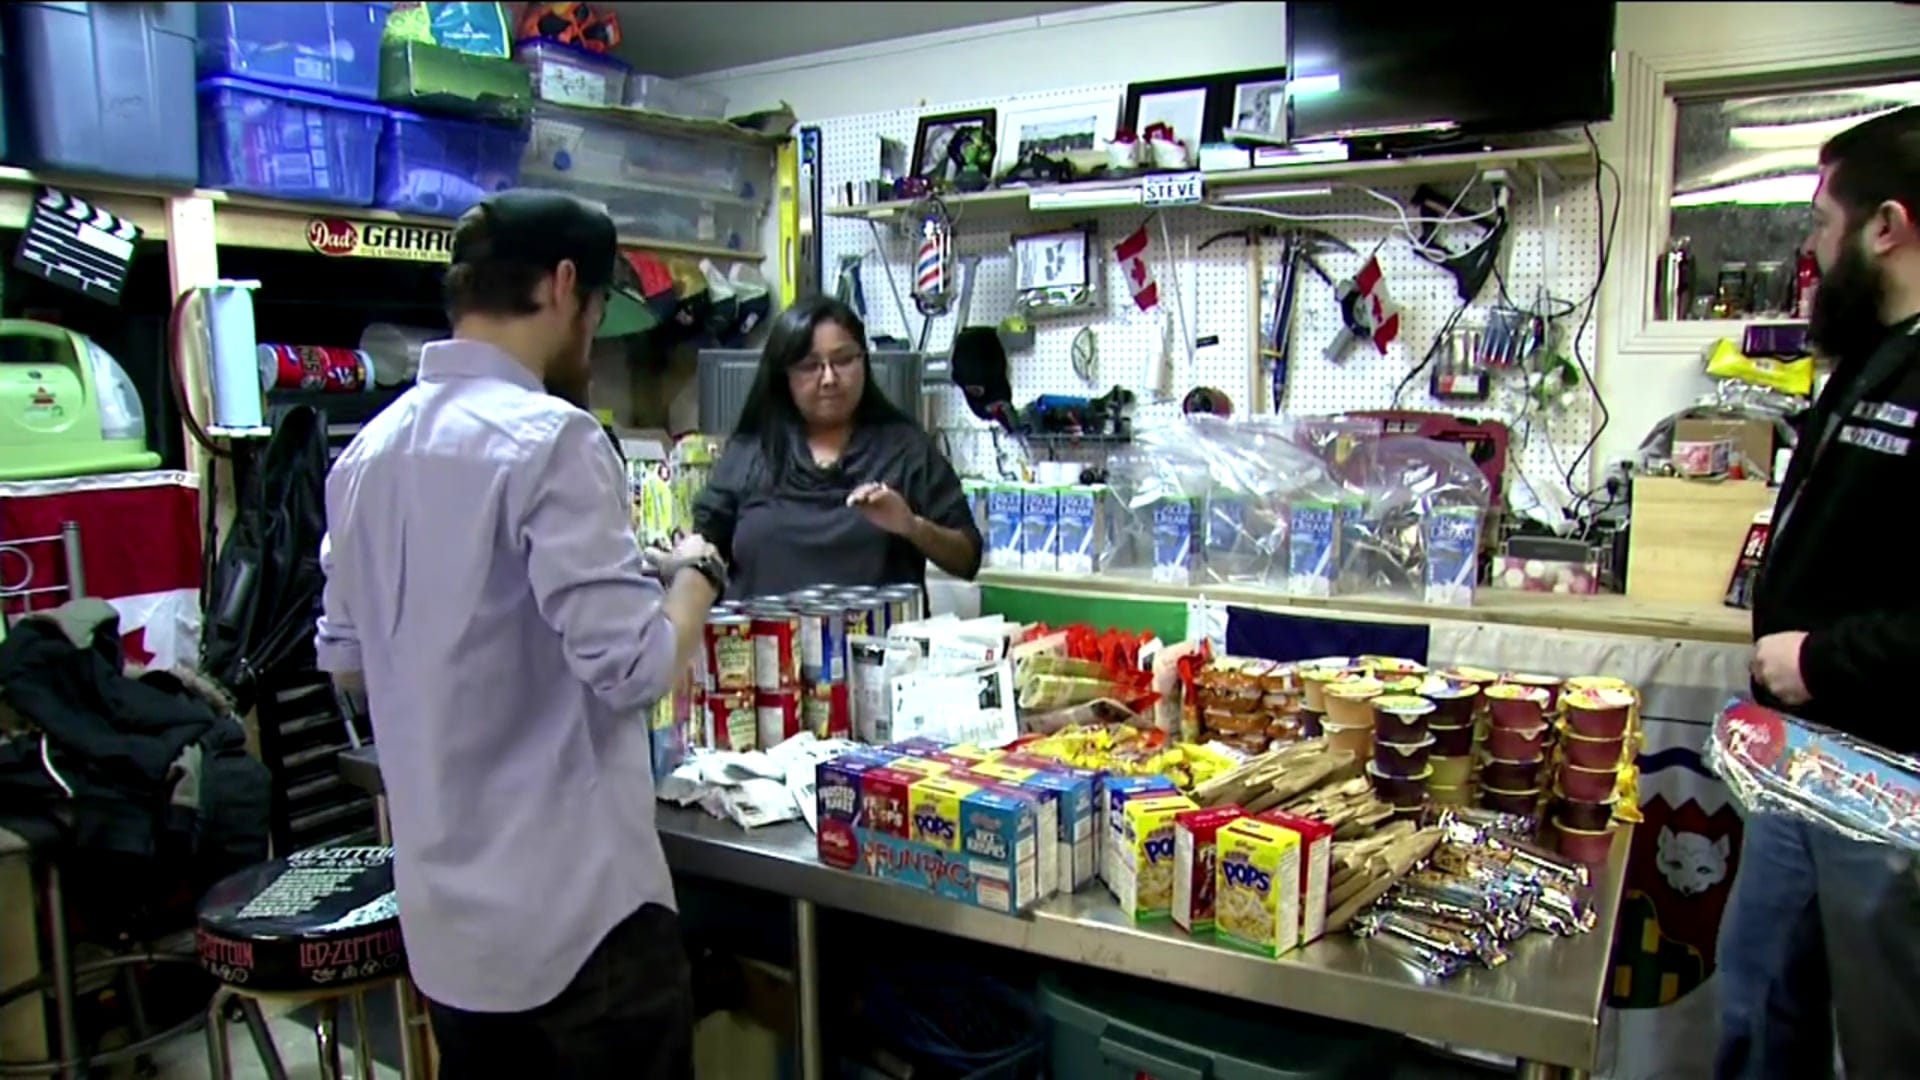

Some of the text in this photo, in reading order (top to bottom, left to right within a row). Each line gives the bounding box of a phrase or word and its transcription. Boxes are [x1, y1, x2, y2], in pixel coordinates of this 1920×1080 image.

[1146, 182, 1195, 199] STEVE
[914, 814, 956, 840] POPS
[1222, 860, 1270, 892] POPS
